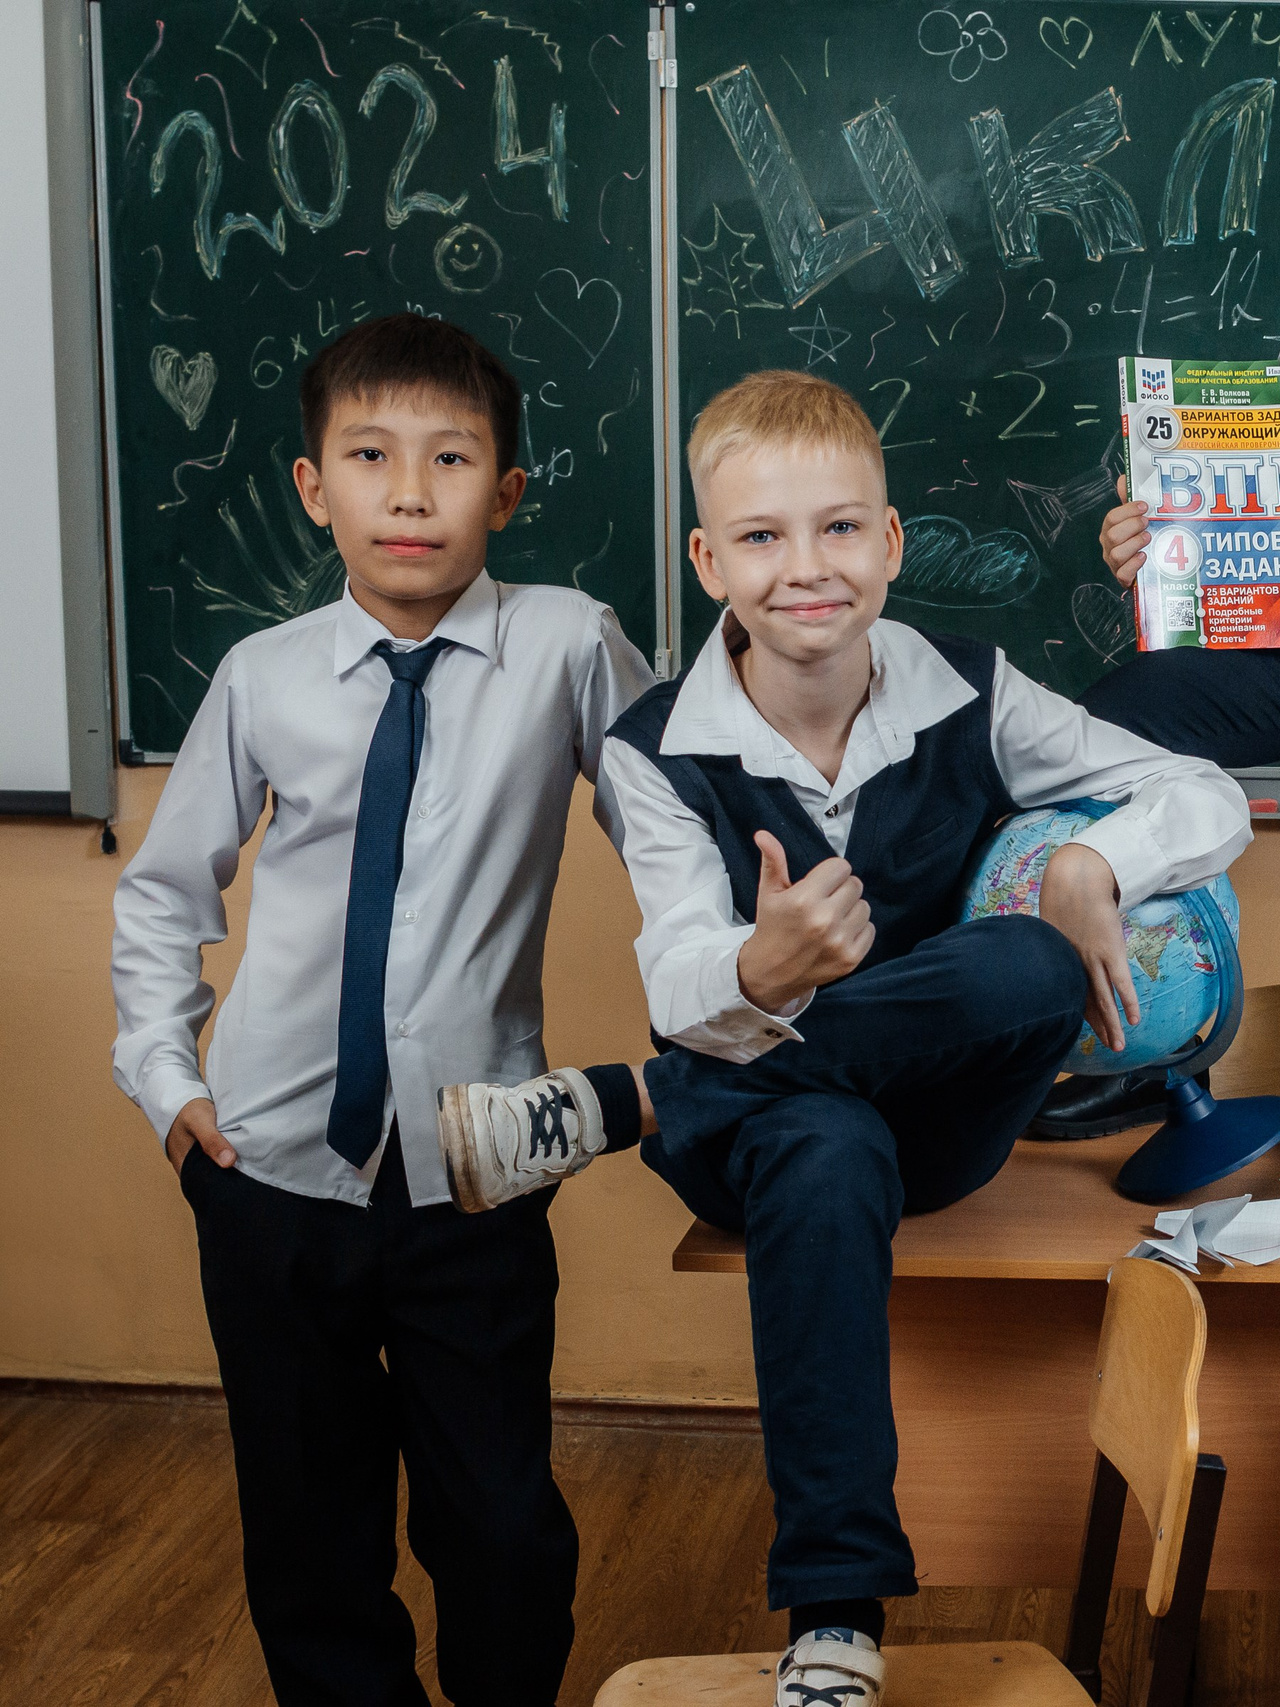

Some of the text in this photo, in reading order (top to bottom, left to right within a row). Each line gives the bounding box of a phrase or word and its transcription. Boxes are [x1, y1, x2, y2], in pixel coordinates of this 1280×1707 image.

[150, 55, 570, 280] 2024
[1187, 369, 1264, 377] ФЕДЕРАЛЬНЫЙ ИНСТИТУТ
[1232, 377, 1278, 385] ОБРАЗОВАНИЯ
[1140, 393, 1169, 401] ФИОКО
[1219, 389, 1250, 397] Волкова
[993, 370, 1060, 441] 2
[1219, 397, 1251, 405] Цитович
[1181, 411, 1253, 421] ВАРИАНТОВ
[1146, 416, 1172, 440] 25
[1182, 441, 1239, 449] ВСЕРОССИЙСКАЯ
[1164, 535, 1189, 571] 4
[1163, 583, 1195, 591] класс
[1207, 586, 1280, 596] 25 ВАРИАНТОВ
[1207, 595, 1254, 605] ЗАДАНИЙ
[1208, 607, 1263, 617] Подробные
[1209, 616, 1253, 625] критерии
[1210, 624, 1266, 633] оценивания
[1210, 635, 1247, 644] Ответы
